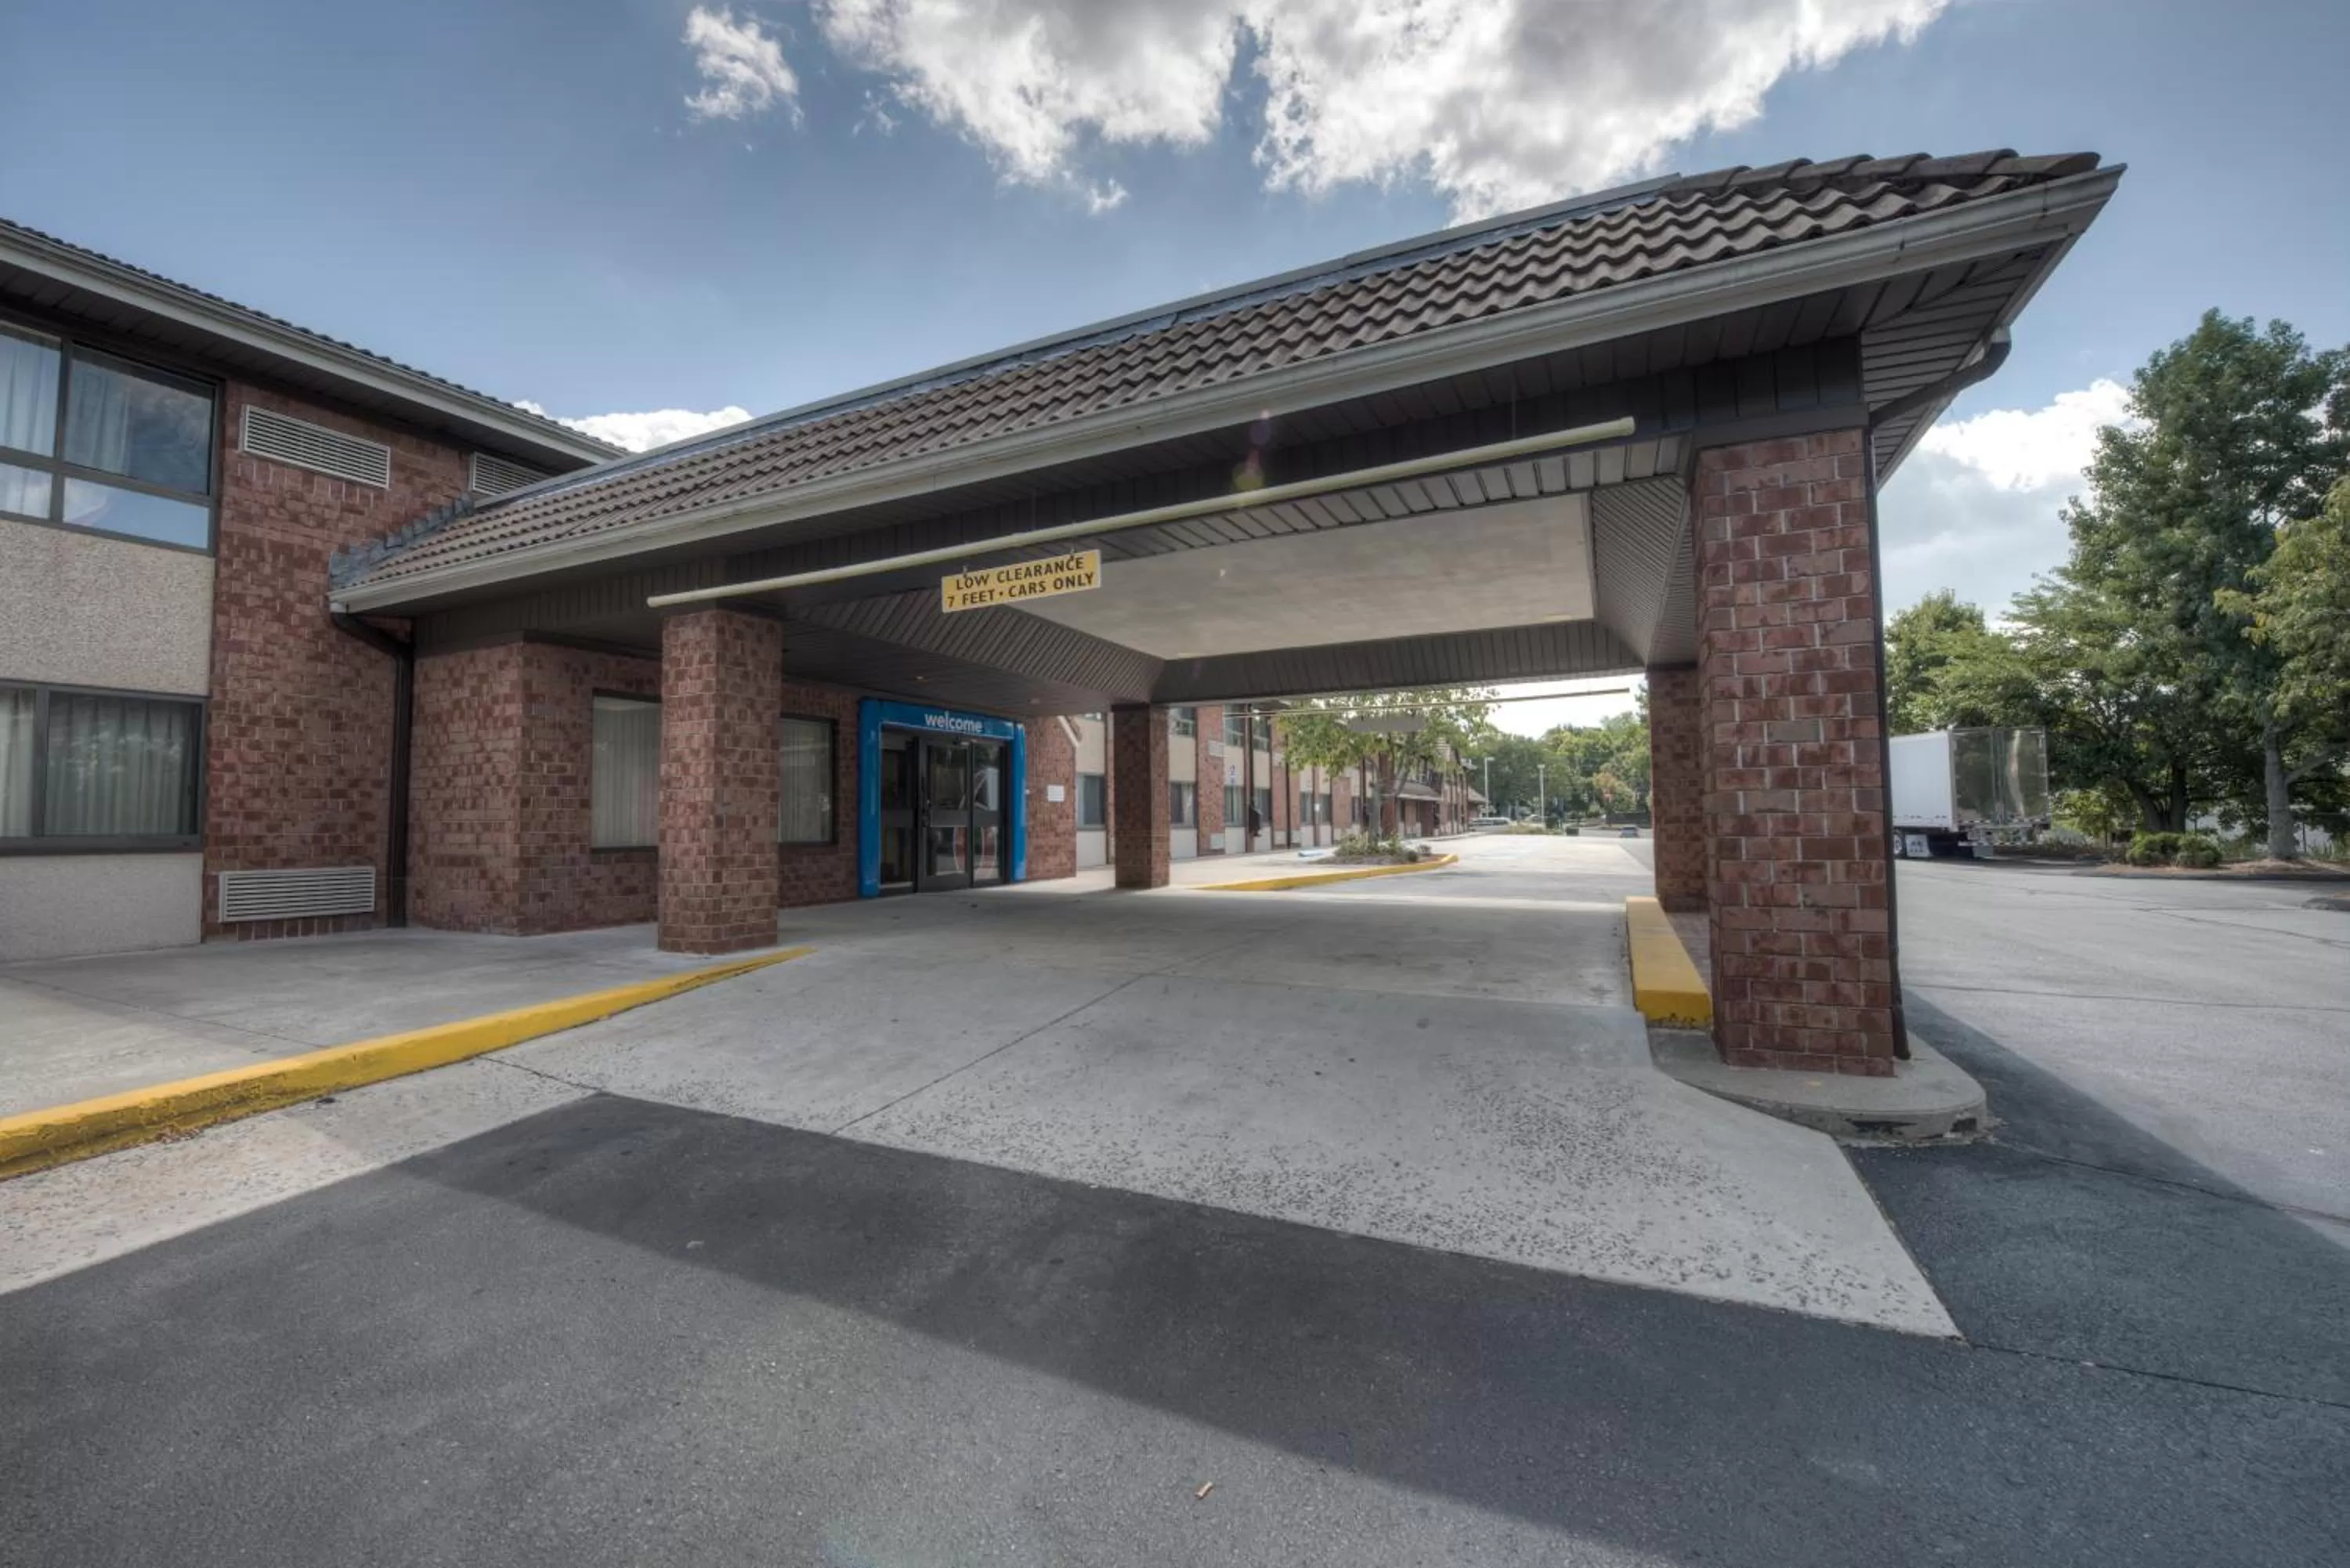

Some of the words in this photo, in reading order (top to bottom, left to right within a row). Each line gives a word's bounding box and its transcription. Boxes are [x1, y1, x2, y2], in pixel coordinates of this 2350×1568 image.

[947, 596, 955, 608] 7
[962, 589, 996, 605] FEET
[1008, 580, 1047, 598] CARS
[1053, 572, 1094, 590] ONLY
[956, 574, 990, 591] LOW
[997, 557, 1085, 583] CLEARANCE
[924, 710, 983, 732] welcome
